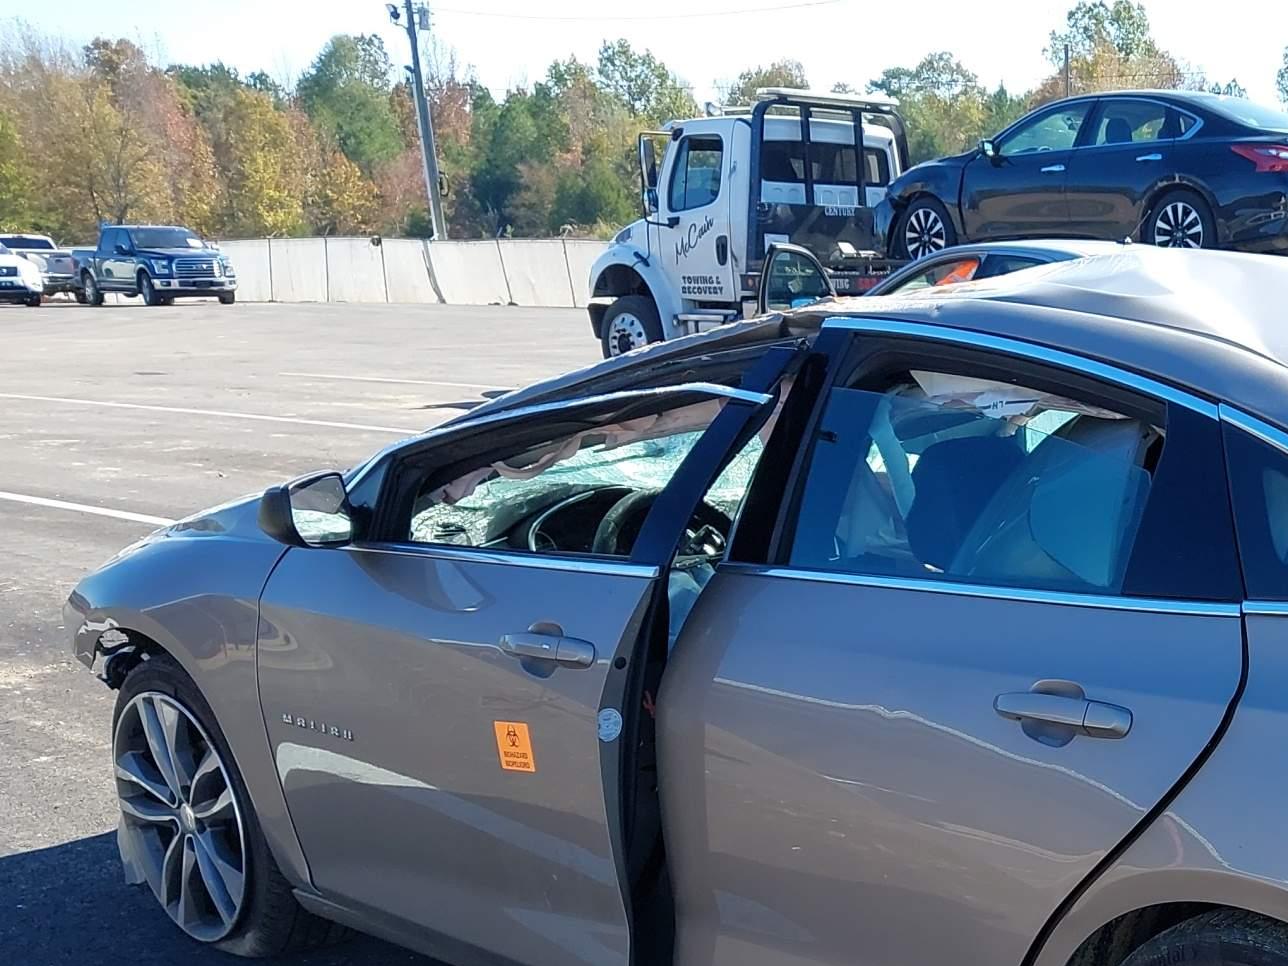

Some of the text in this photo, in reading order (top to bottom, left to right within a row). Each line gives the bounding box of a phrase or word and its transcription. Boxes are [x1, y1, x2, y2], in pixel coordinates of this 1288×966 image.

[824, 206, 855, 217] CENTURY
[675, 215, 714, 265] McCain
[681, 275, 721, 285] TOWING &
[681, 286, 723, 295] RECOVERY
[282, 713, 354, 741] MALIBU
